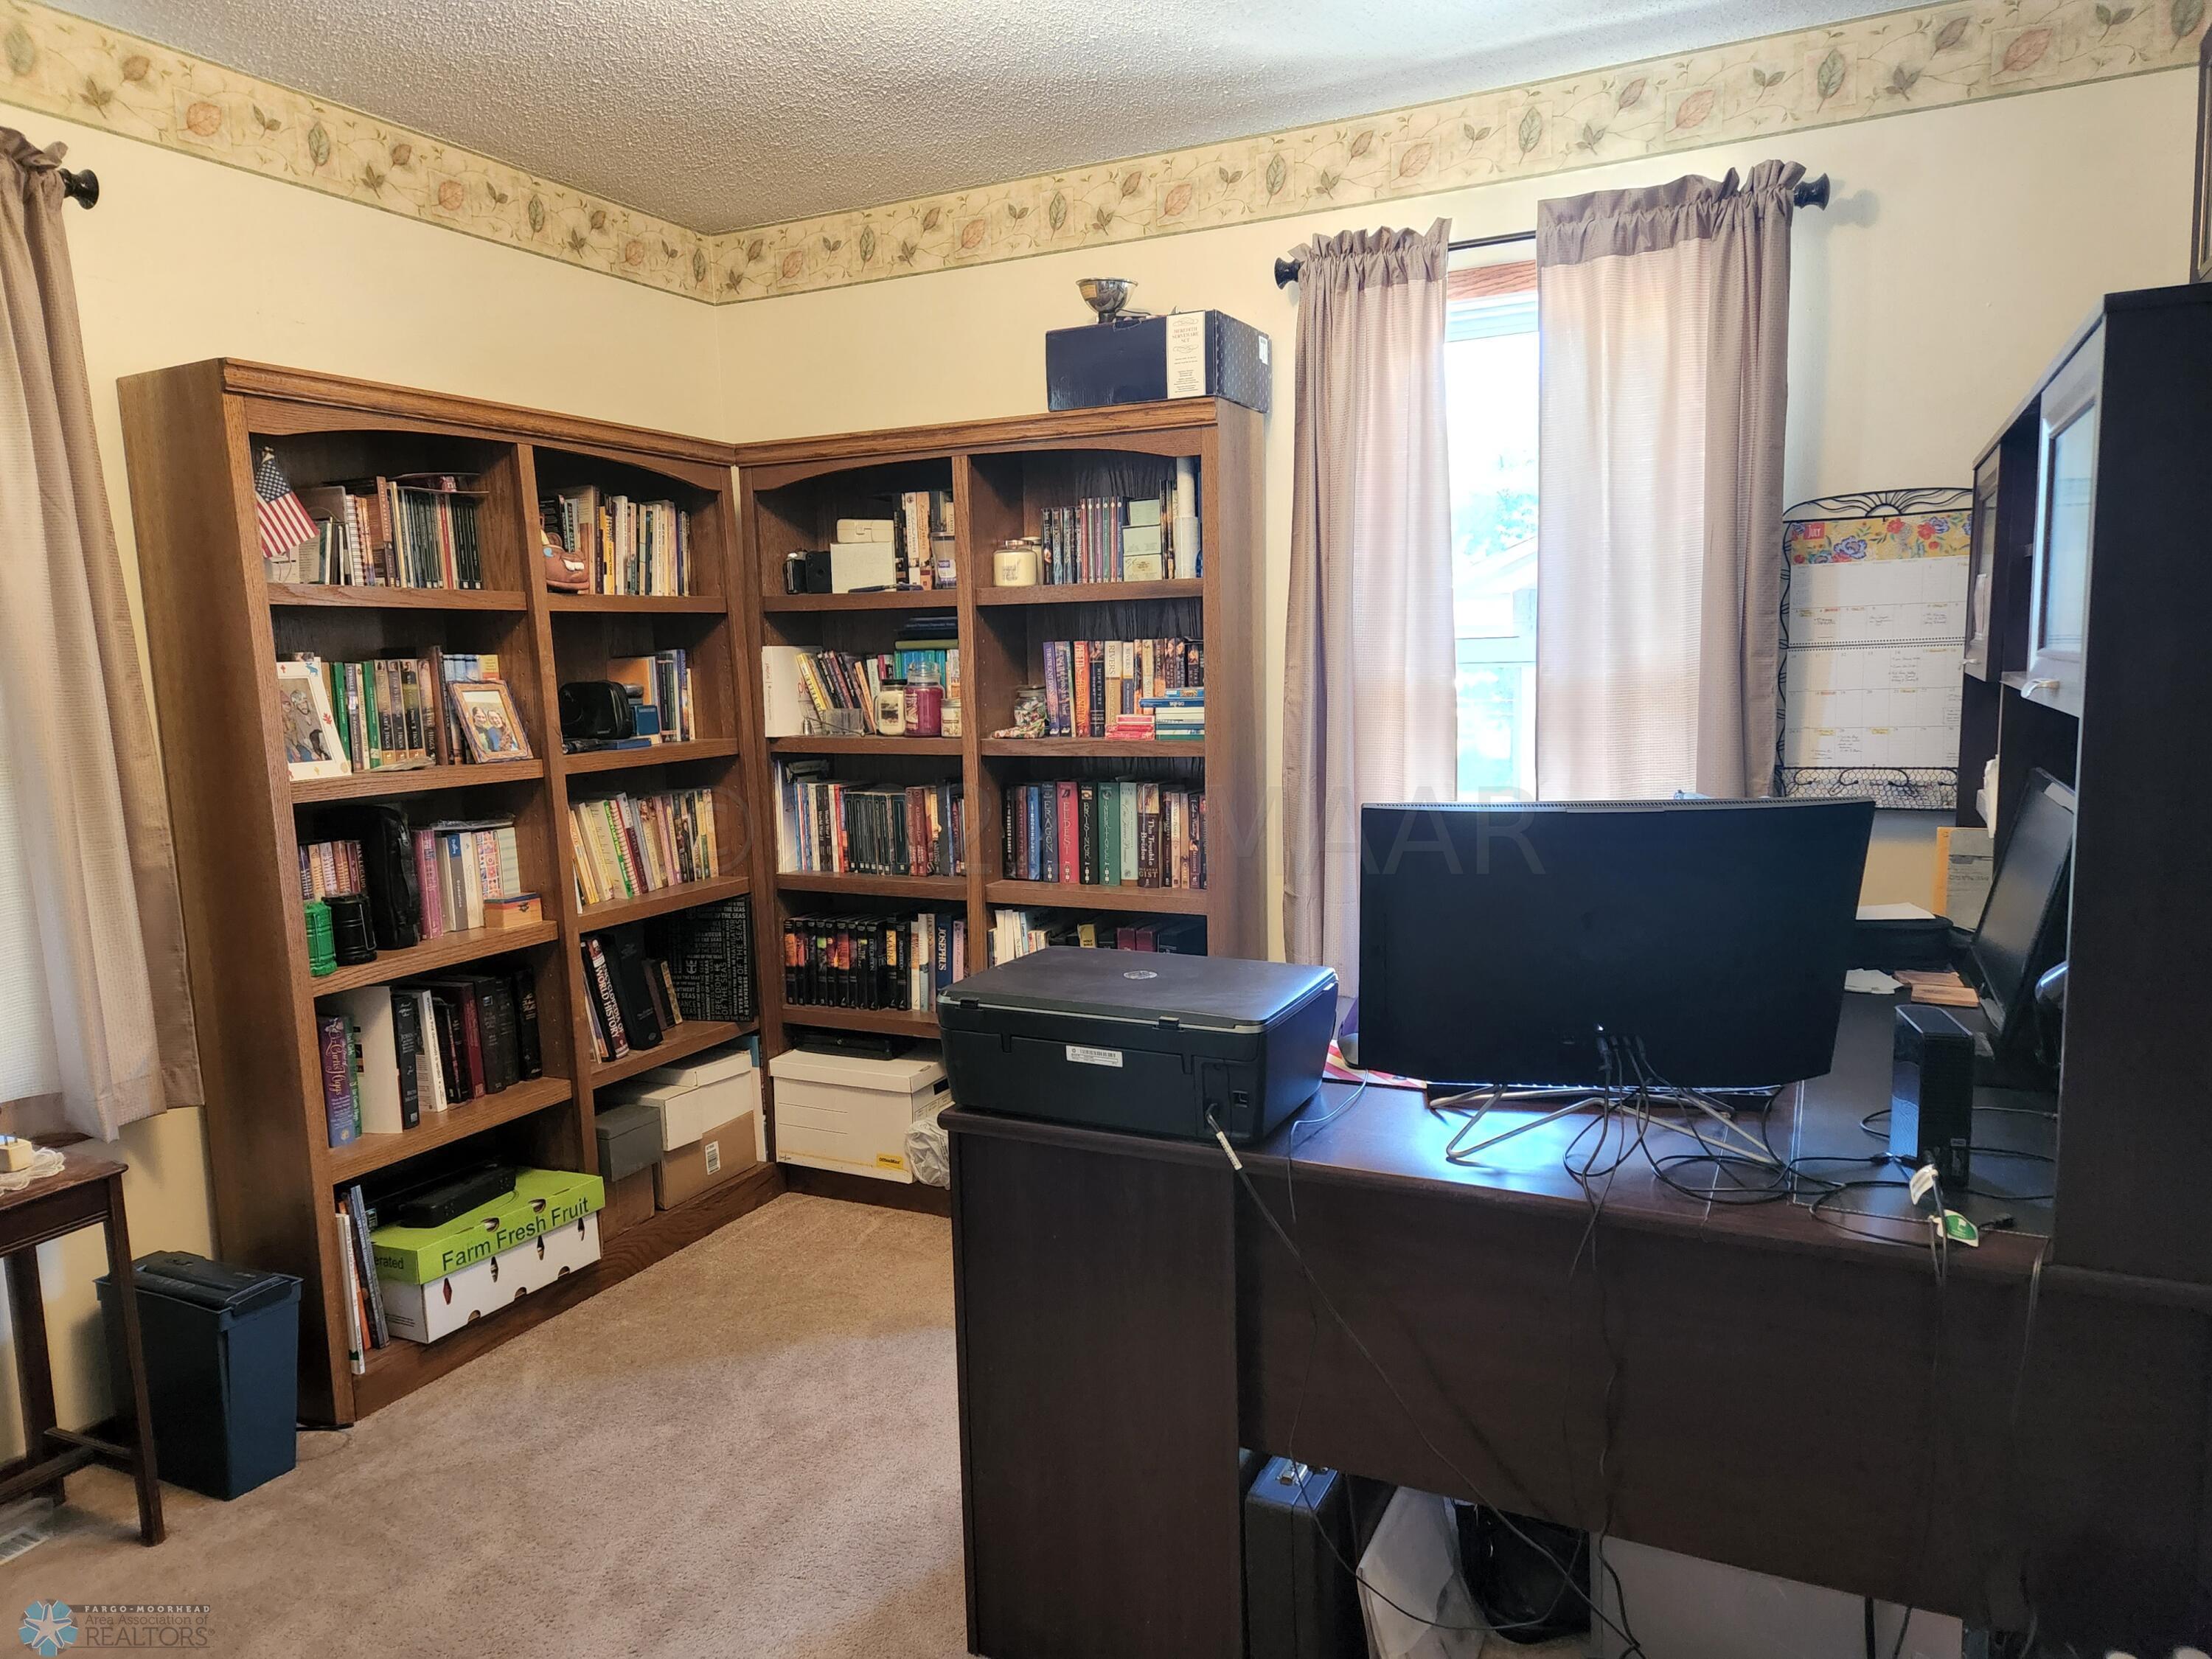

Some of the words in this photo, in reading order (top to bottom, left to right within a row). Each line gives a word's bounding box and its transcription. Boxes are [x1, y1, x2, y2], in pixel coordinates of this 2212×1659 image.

[1044, 801, 1053, 854] ERAGON
[1063, 801, 1071, 855] ELDEST
[938, 928, 947, 971] JOSEPHUS
[595, 967, 610, 1001] WORLD
[603, 1002, 620, 1039] HISTORY
[602, 964, 621, 1023] ENCYCLOPEDIA
[617, 1023, 624, 1034] OF
[722, 1003, 728, 1015] OF
[442, 1240, 491, 1272] Farm
[497, 1217, 546, 1249] Fresh
[552, 1197, 590, 1227] Fruit
[375, 1257, 405, 1270] erated
